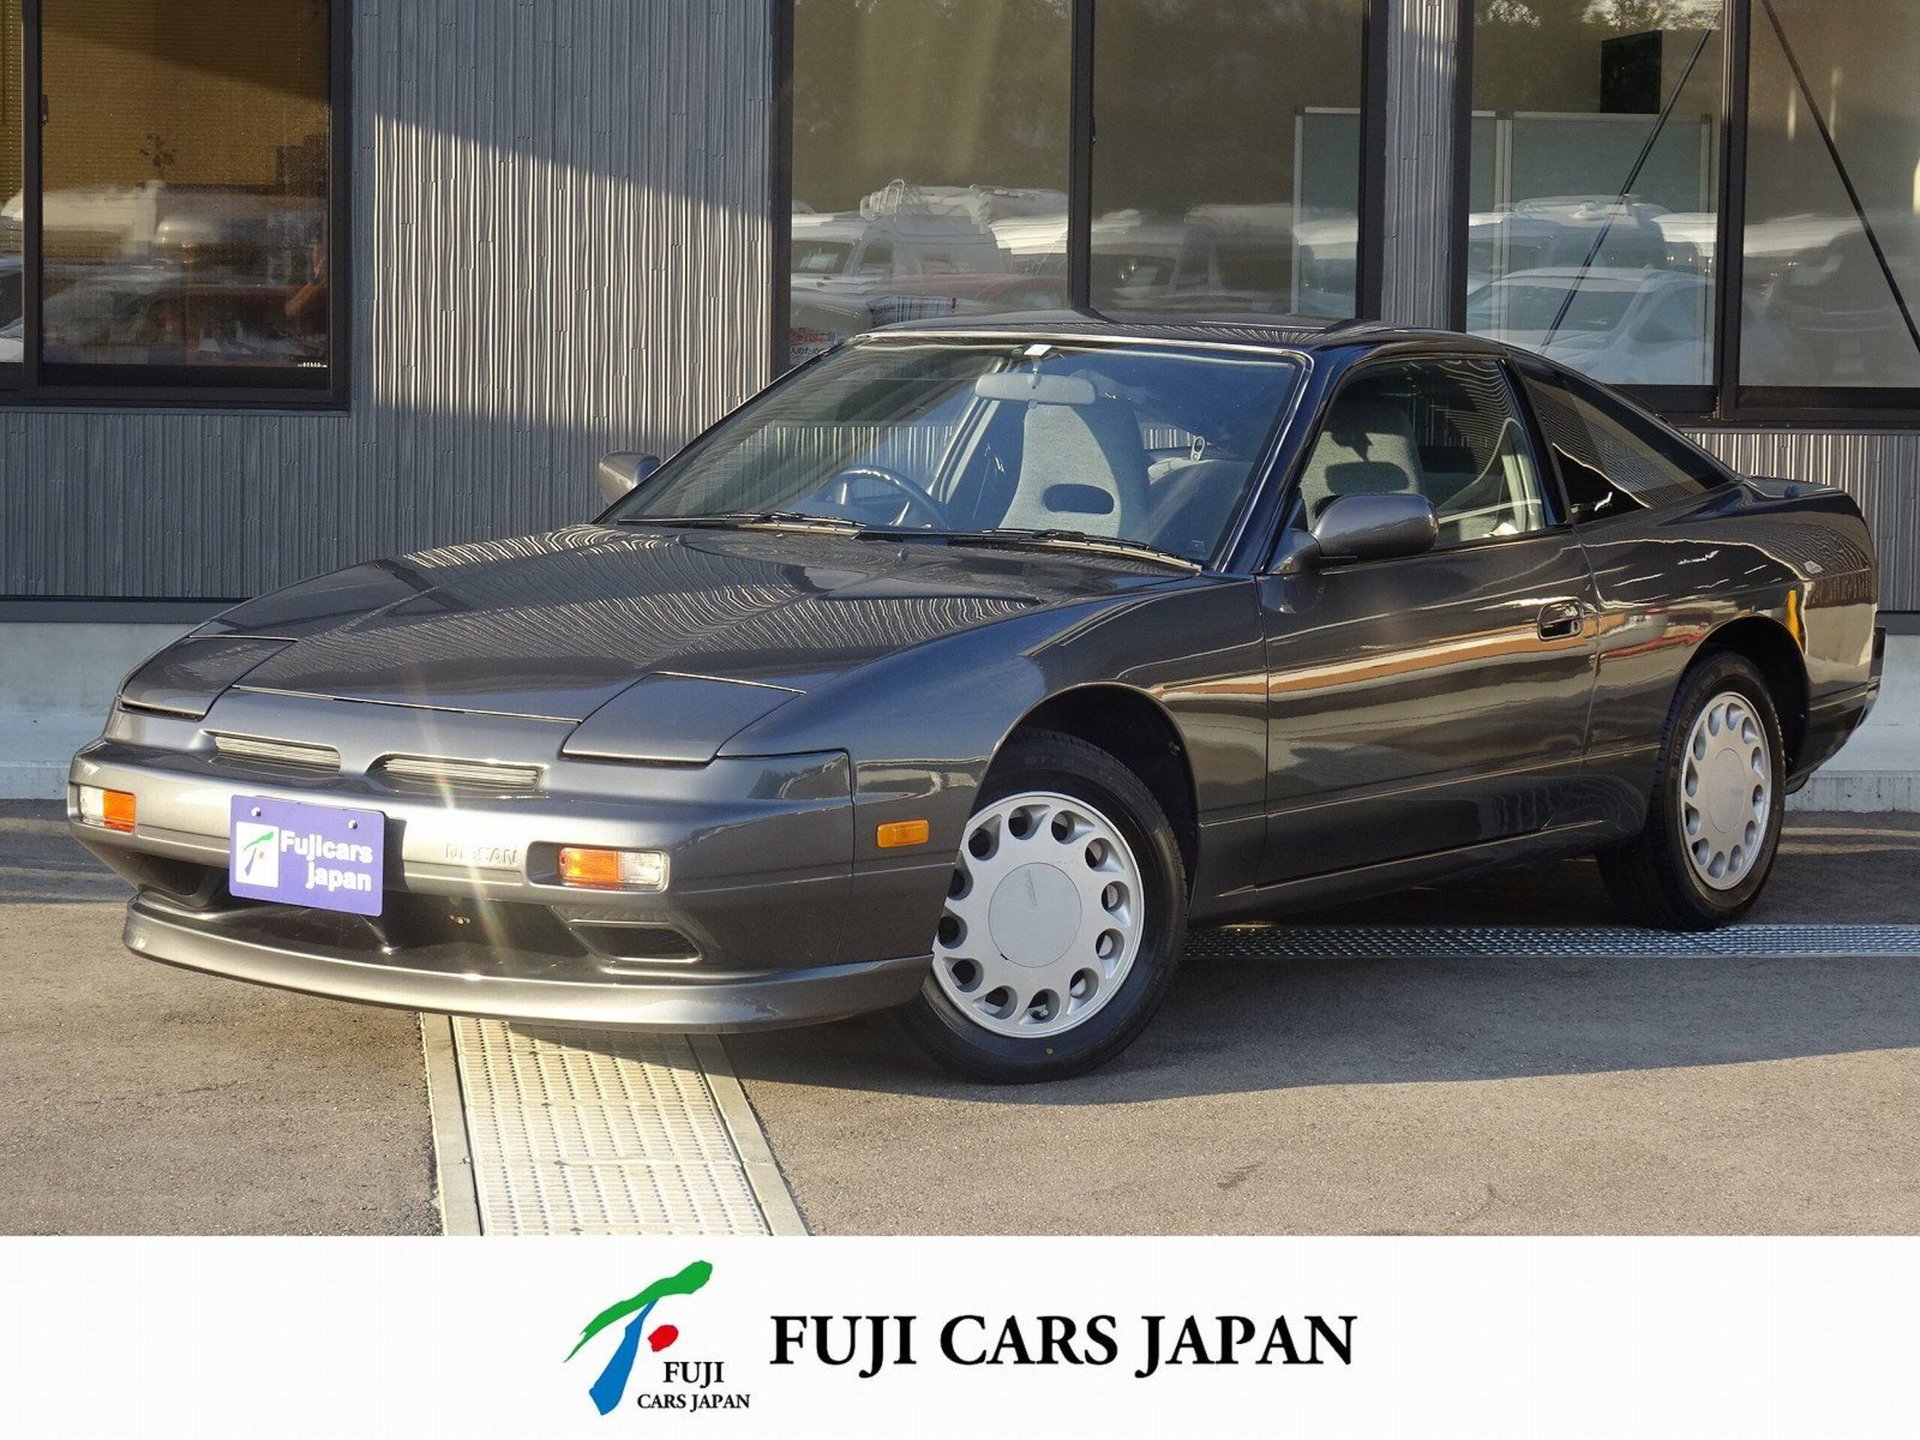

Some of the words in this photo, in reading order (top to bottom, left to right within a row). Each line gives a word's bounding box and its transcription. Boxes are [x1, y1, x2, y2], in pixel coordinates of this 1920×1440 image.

[280, 829, 373, 864] Fujicars
[445, 843, 518, 866] NISAN
[305, 861, 372, 892] japan
